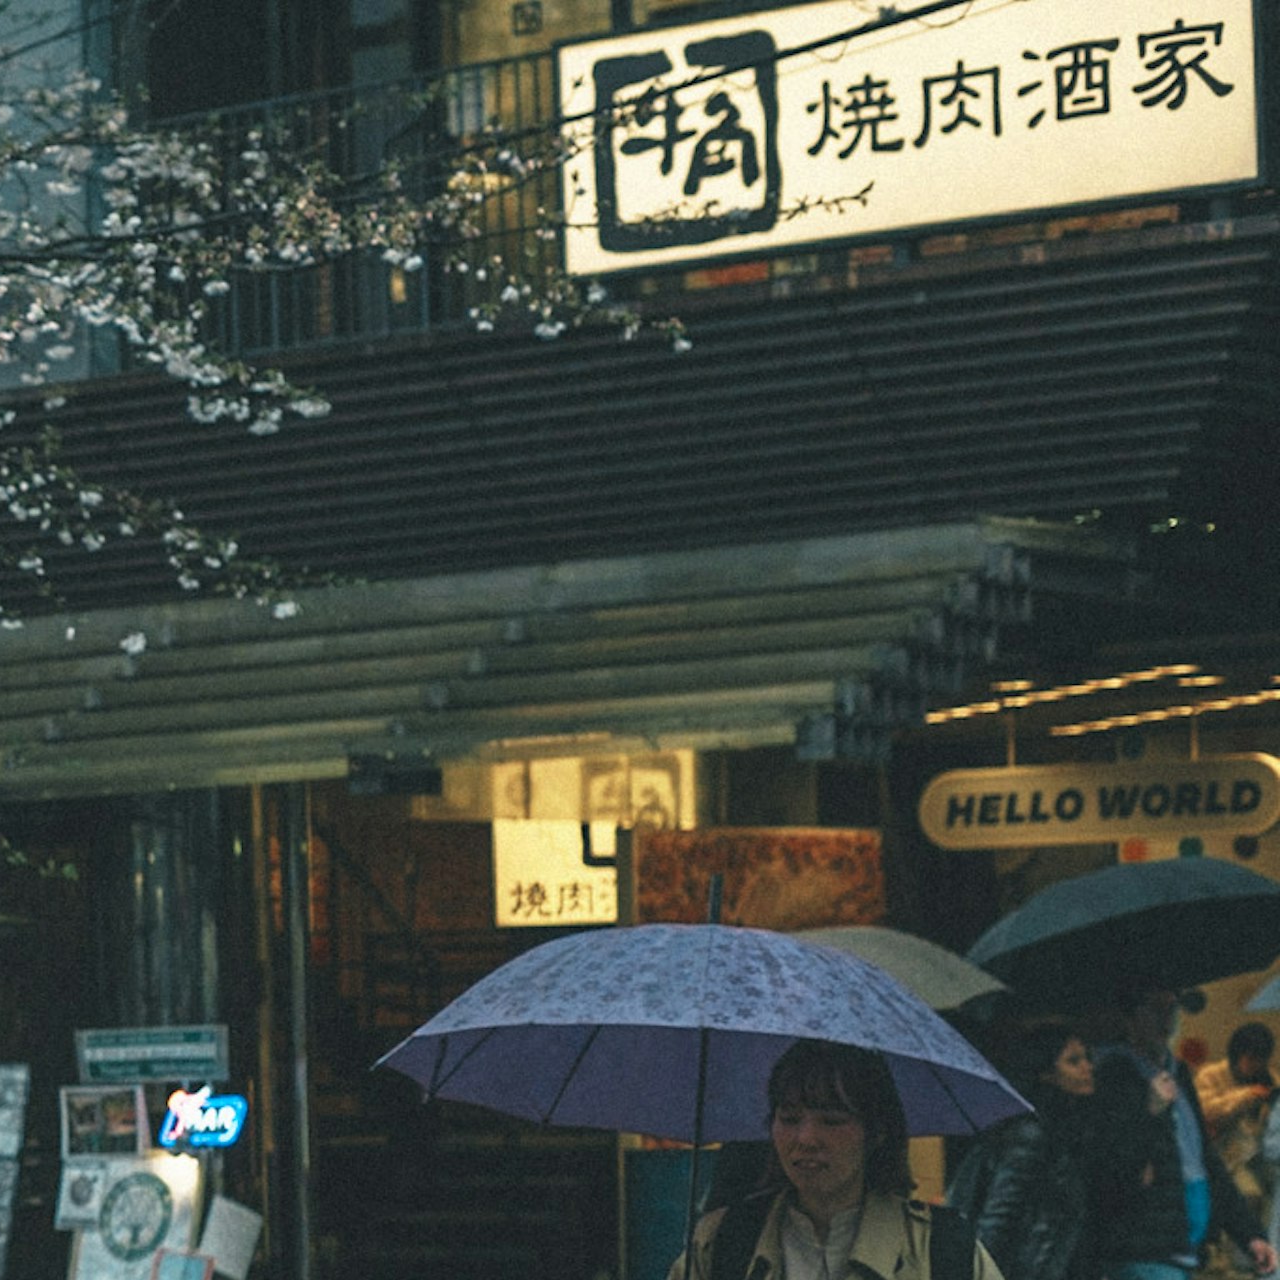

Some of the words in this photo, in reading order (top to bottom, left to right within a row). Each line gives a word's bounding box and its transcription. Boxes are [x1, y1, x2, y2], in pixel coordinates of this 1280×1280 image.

[805, 19, 1235, 159] 焼肉酒家
[946, 788, 1085, 828] HELLO
[1097, 779, 1263, 821] WORLD
